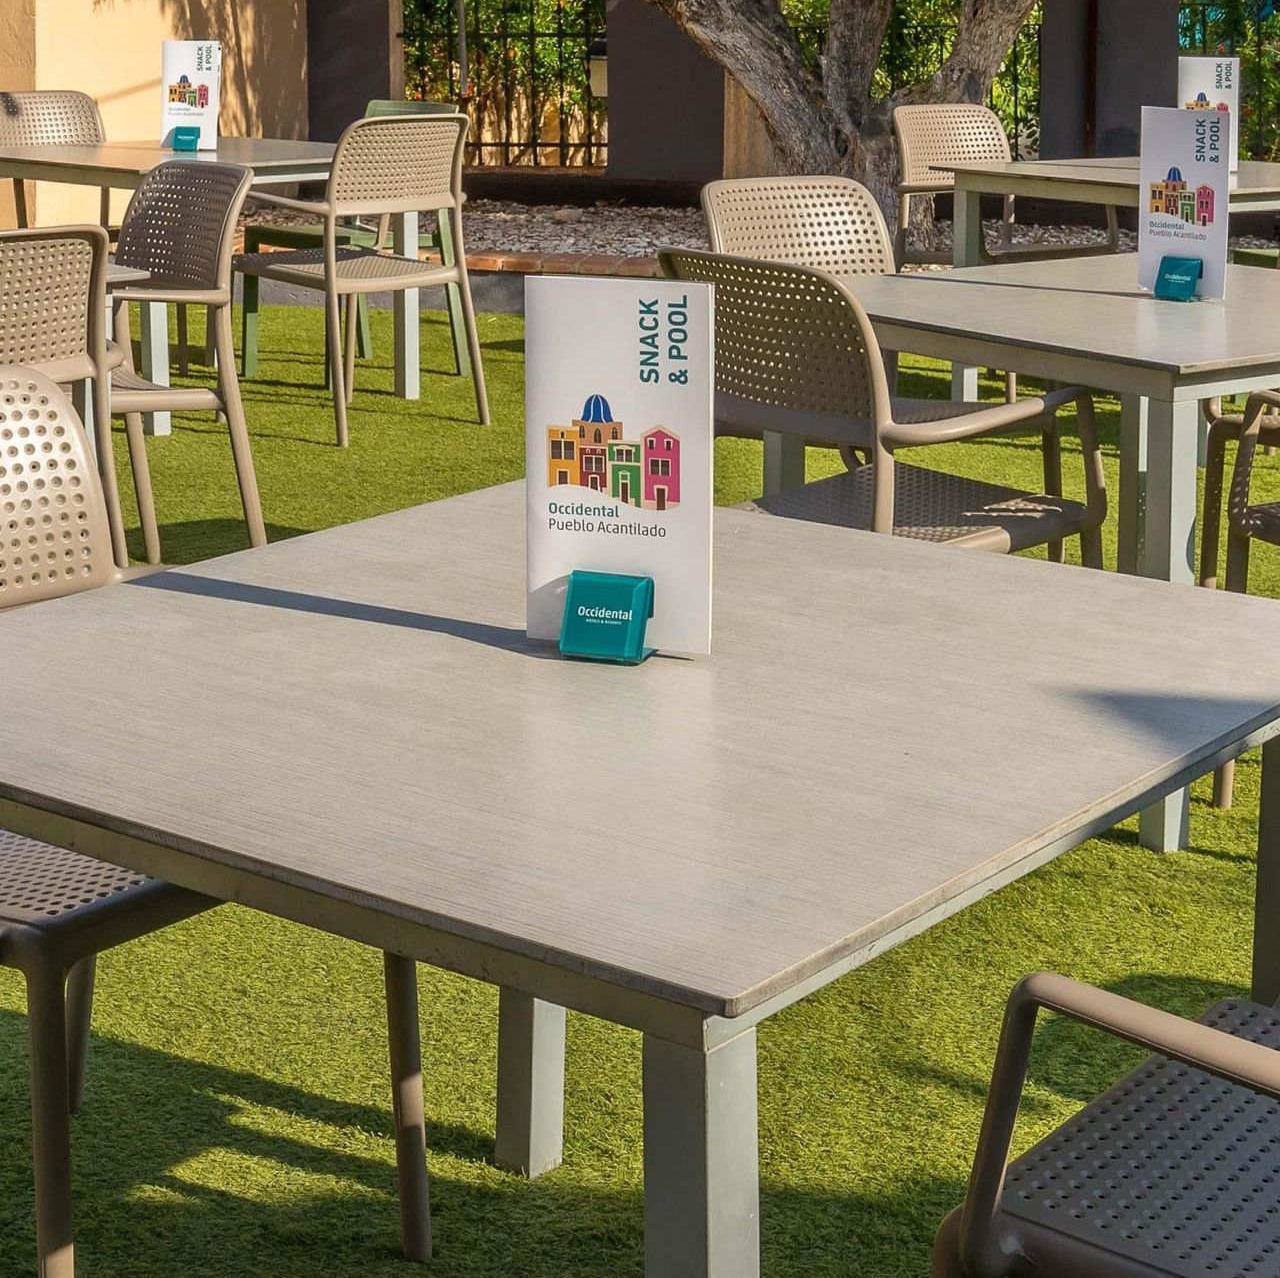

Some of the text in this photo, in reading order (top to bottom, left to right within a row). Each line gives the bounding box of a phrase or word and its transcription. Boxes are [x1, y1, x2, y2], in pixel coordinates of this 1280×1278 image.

[1195, 118, 1206, 162] SNACK
[1209, 117, 1221, 164] & POOL
[638, 298, 660, 384] SNACK
[667, 295, 689, 385] & POOL
[548, 502, 620, 518] Occidental
[548, 518, 667, 538] Pueblo Acantilado
[577, 606, 633, 621] Occidental
